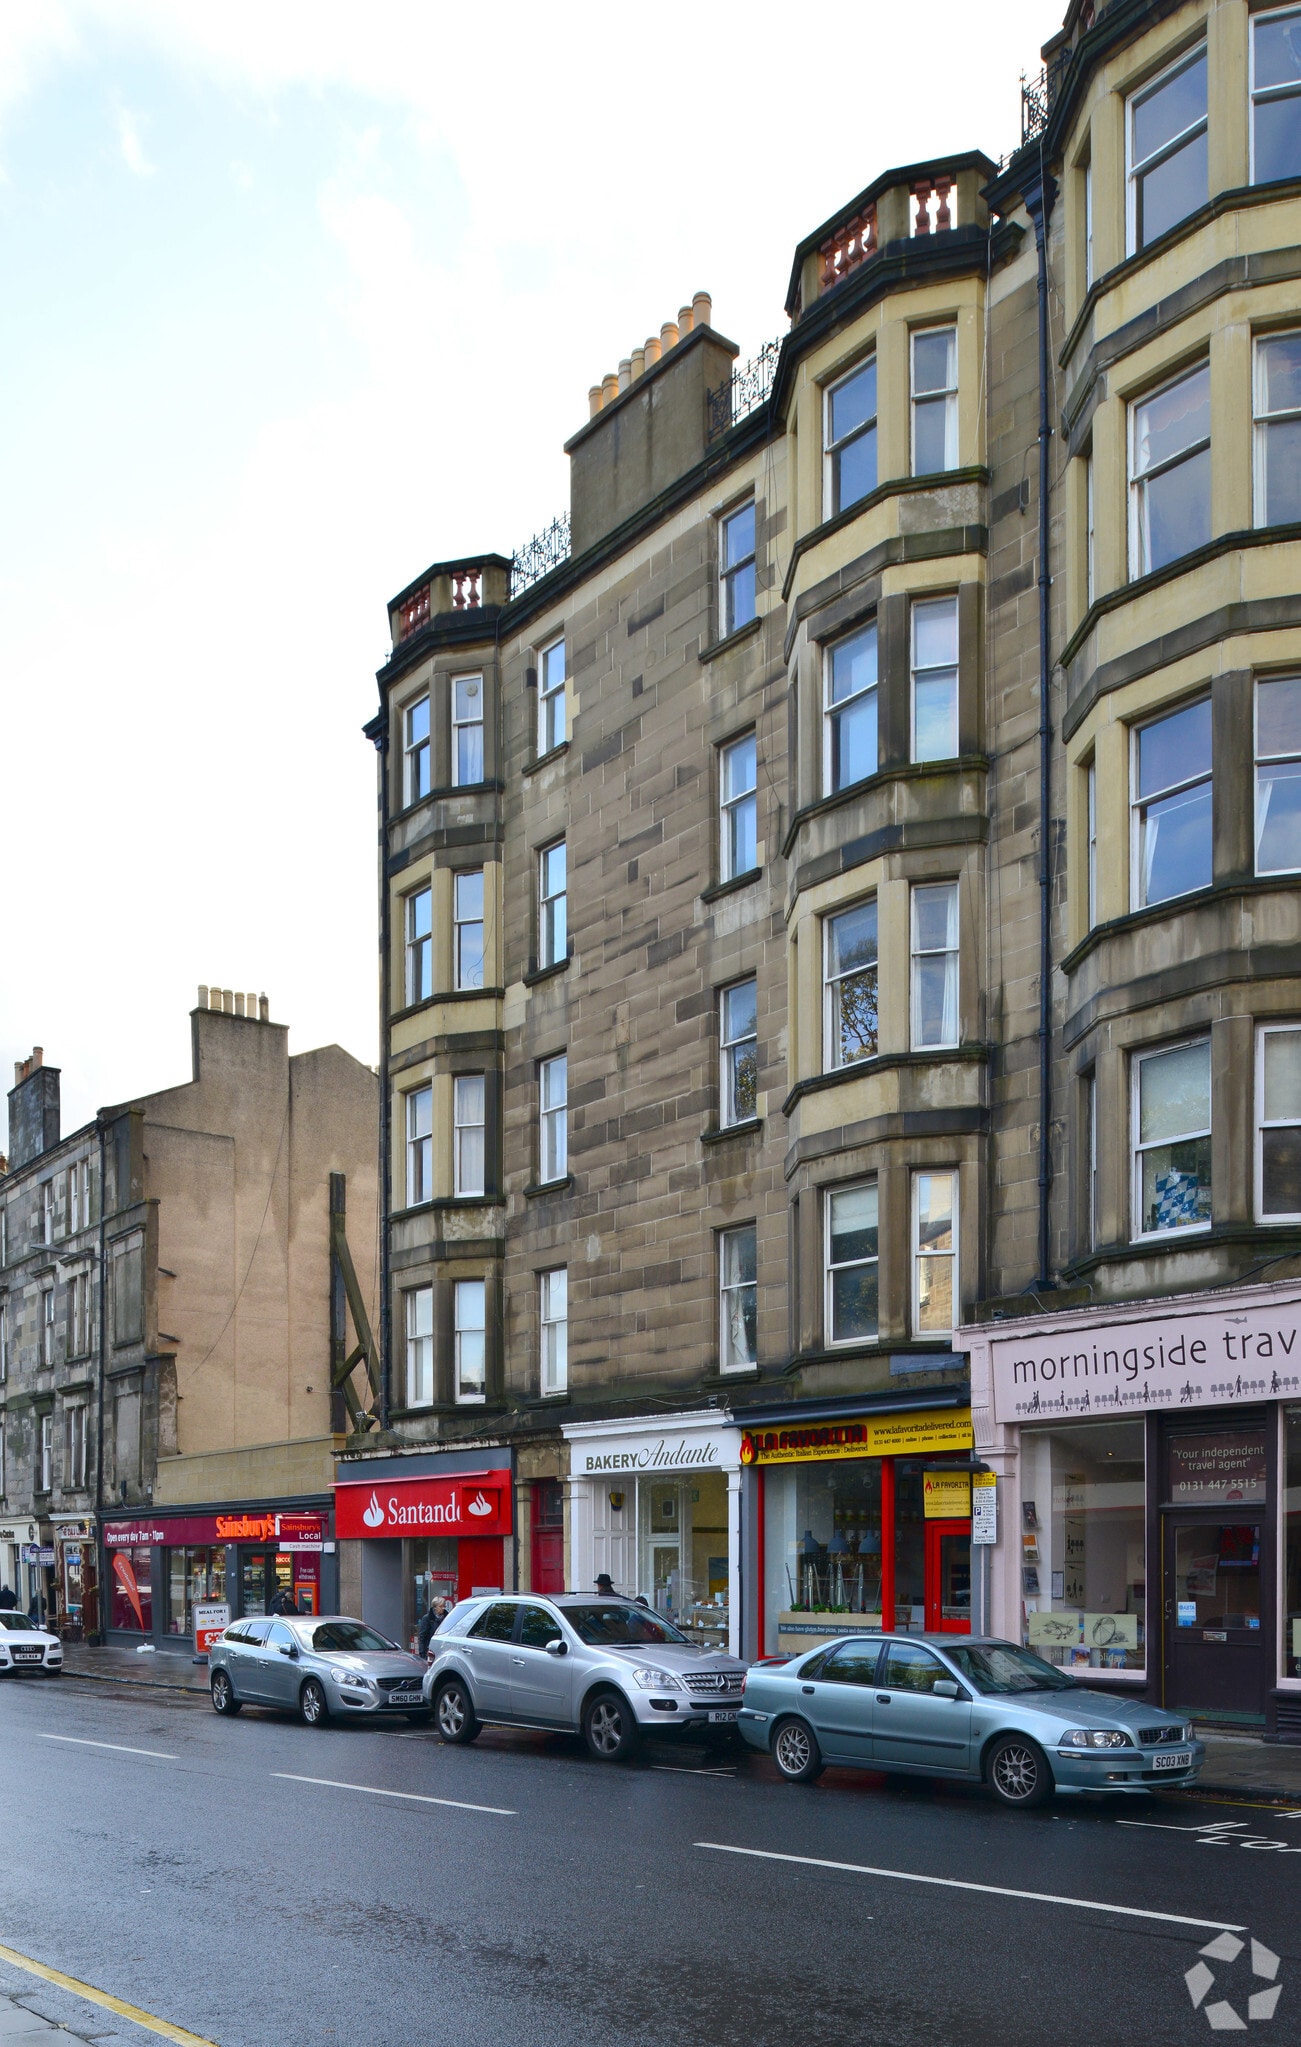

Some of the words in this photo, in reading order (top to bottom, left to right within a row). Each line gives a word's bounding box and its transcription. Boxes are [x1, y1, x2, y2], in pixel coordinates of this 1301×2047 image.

[1013, 1334, 1207, 1384] morningside
[1222, 1329, 1297, 1361] trav
[873, 1420, 972, 1436] www.lafavoritadelivered.com
[751, 1431, 778, 1451] LA
[778, 1423, 868, 1450] FAVORITA
[586, 1453, 638, 1470] BAKERY
[637, 1439, 719, 1468] Andante
[761, 1452, 770, 1460] The
[771, 1450, 795, 1459] Authentic
[795, 1449, 812, 1457] Italian
[812, 1447, 840, 1457] Experience
[844, 1444, 868, 1452] Delivered
[1172, 1449, 1199, 1459] "Your
[1201, 1445, 1264, 1459] independent
[1188, 1459, 1215, 1470] travel
[1218, 1457, 1250, 1471] agent"
[932, 1481, 940, 1489] LA
[941, 1481, 969, 1489] FAVORITA
[1180, 1480, 1204, 1491] 0131
[1208, 1480, 1227, 1490] 447
[1231, 1478, 1257, 1489] 5515
[975, 1507, 981, 1515] P
[216, 1513, 275, 1542] Sainsbury's
[281, 1523, 320, 1533] Sainsbury's
[107, 1532, 117, 1544] Open
[118, 1533, 129, 1543] every
[130, 1531, 138, 1543] day
[138, 1530, 149, 1541] 7am
[152, 1529, 164, 1542] 11pm
[299, 1532, 321, 1540] Local
[391, 1695, 408, 1703] SM60
[1155, 1756, 1176, 1768] SC03
[1176, 1754, 1190, 1767] XNB
